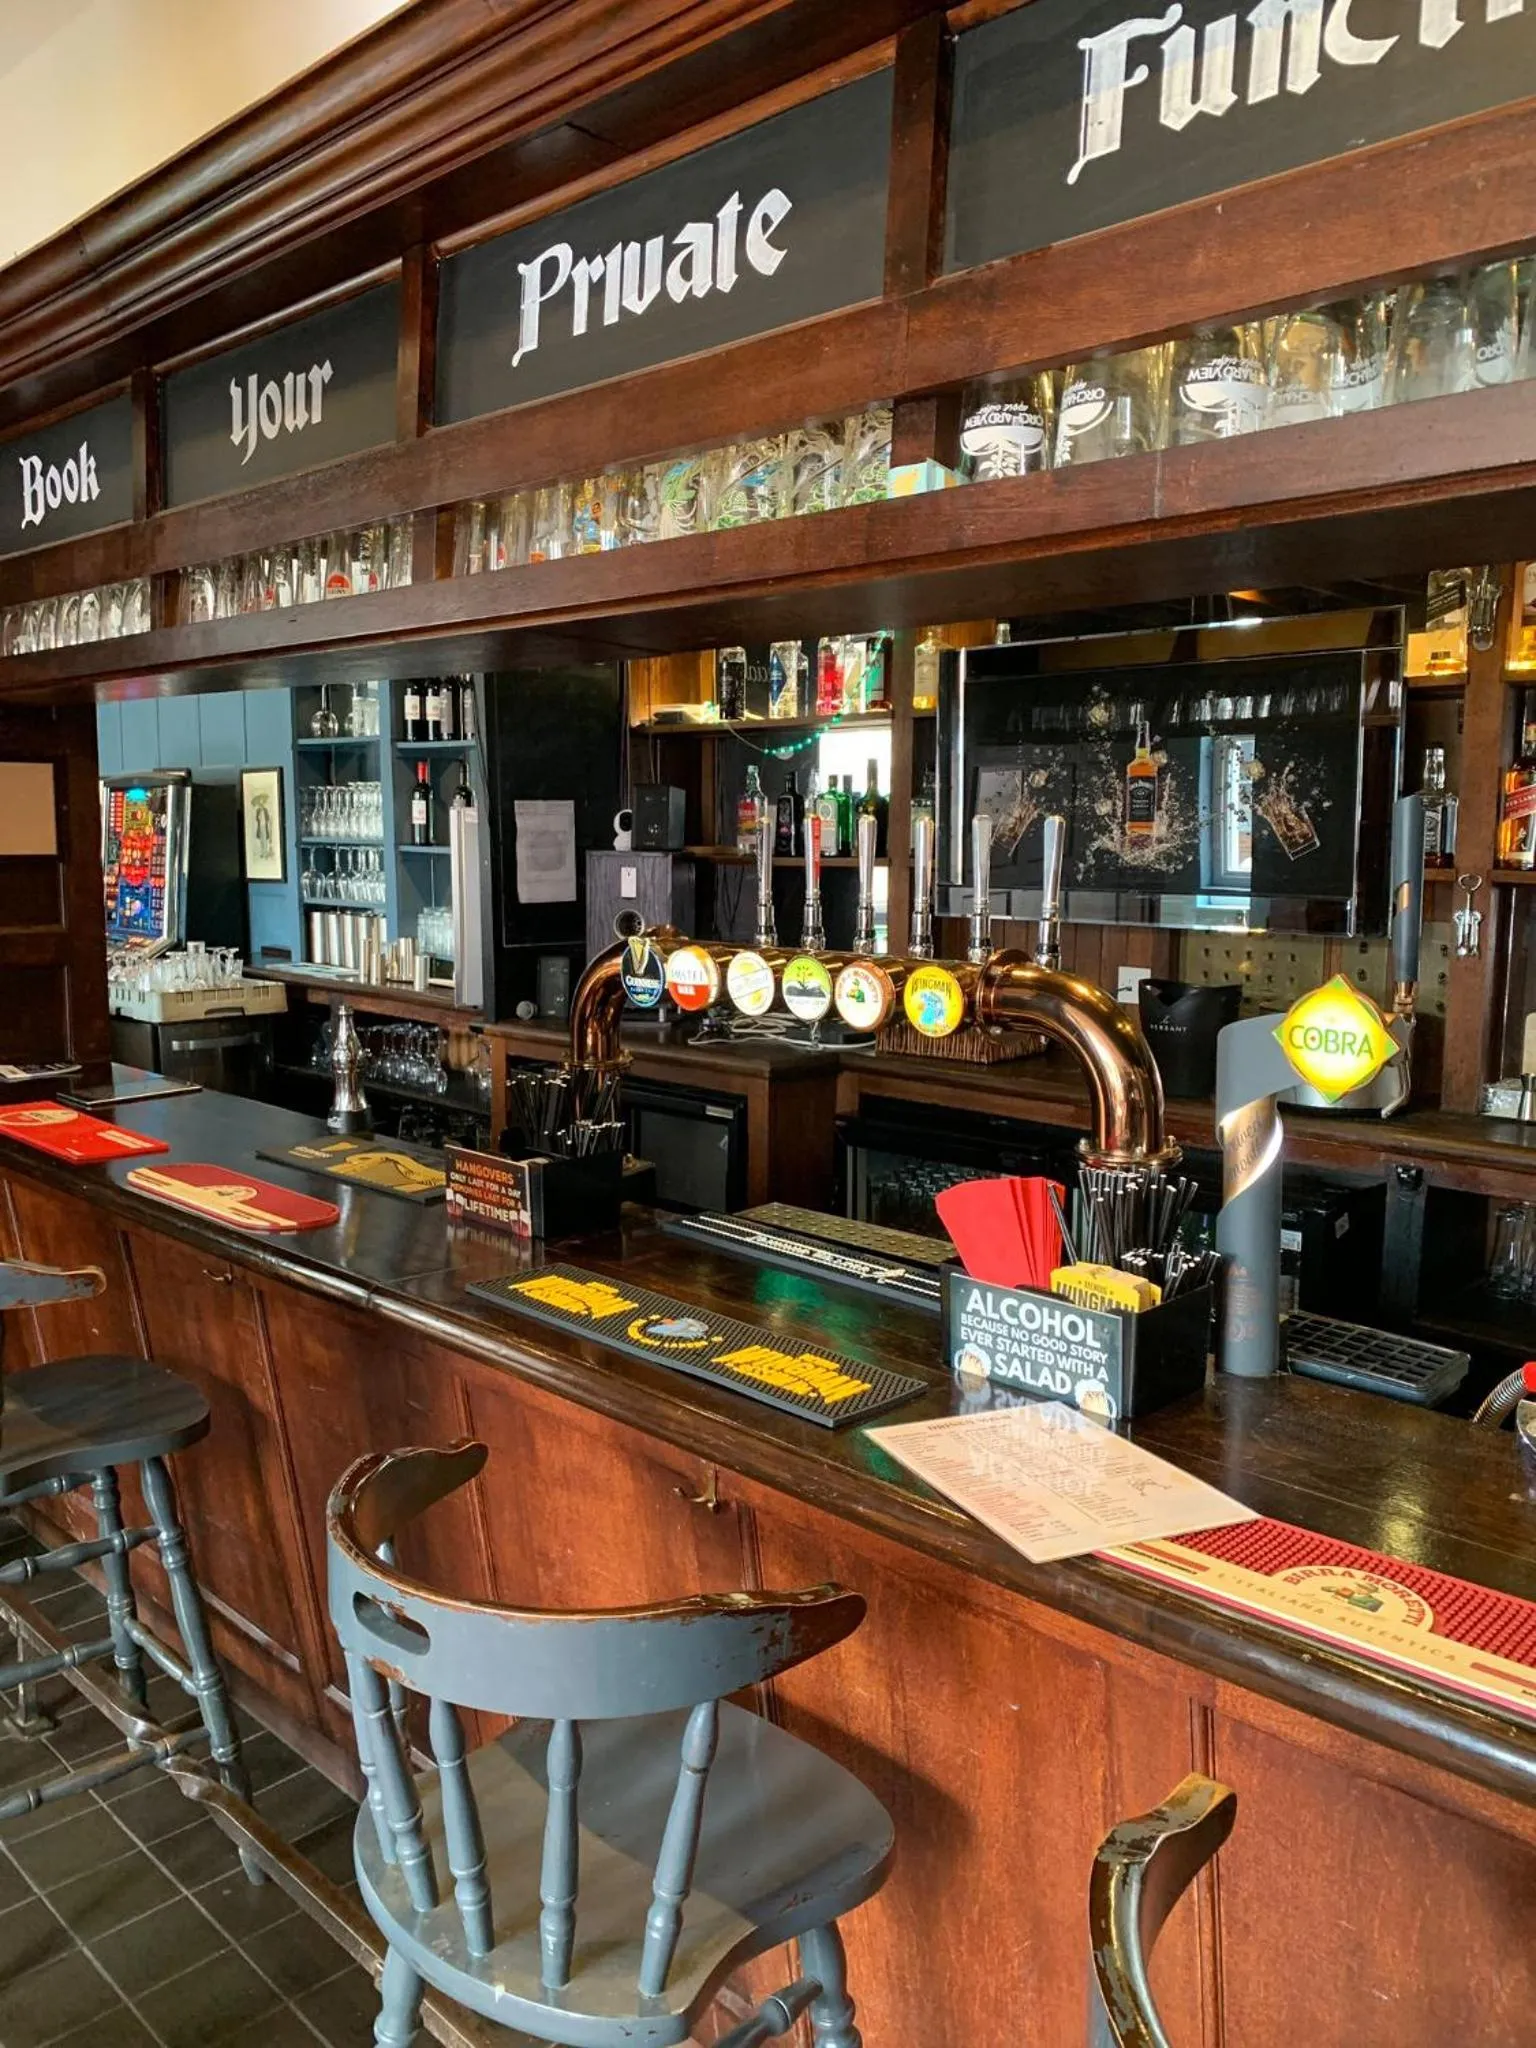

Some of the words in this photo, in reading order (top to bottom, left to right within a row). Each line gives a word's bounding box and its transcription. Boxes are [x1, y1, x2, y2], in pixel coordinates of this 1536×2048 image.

[1067, 0, 1525, 185] Func
[511, 187, 793, 368] Private
[229, 360, 334, 466] Your
[19, 440, 101, 530] Book
[1288, 1024, 1376, 1060] COBRA
[450, 1171, 467, 1182] ONLY
[467, 1176, 484, 1188] LAST
[485, 1181, 499, 1193] FOR
[500, 1186, 507, 1195] A
[507, 1188, 521, 1199] DAY
[455, 1159, 514, 1185] HANGOVERS
[463, 1198, 510, 1222] LIFETIME
[960, 1312, 1009, 1337] BECAUSE
[1011, 1328, 1029, 1342] NO
[1031, 1332, 1068, 1353] GOOD
[1069, 1344, 1109, 1365] STORY
[966, 1288, 1102, 1349] ALCOHOL
[960, 1326, 994, 1348] EVER
[996, 1338, 1055, 1366] STARTED
[1056, 1353, 1095, 1377] WITH
[1097, 1365, 1109, 1383] A
[993, 1353, 1073, 1395] SALAD
[1282, 1567, 1356, 1586] BIRRA
[1360, 1573, 1427, 1628] MORETTI
[1336, 1615, 1456, 1661] AUTENTICA
